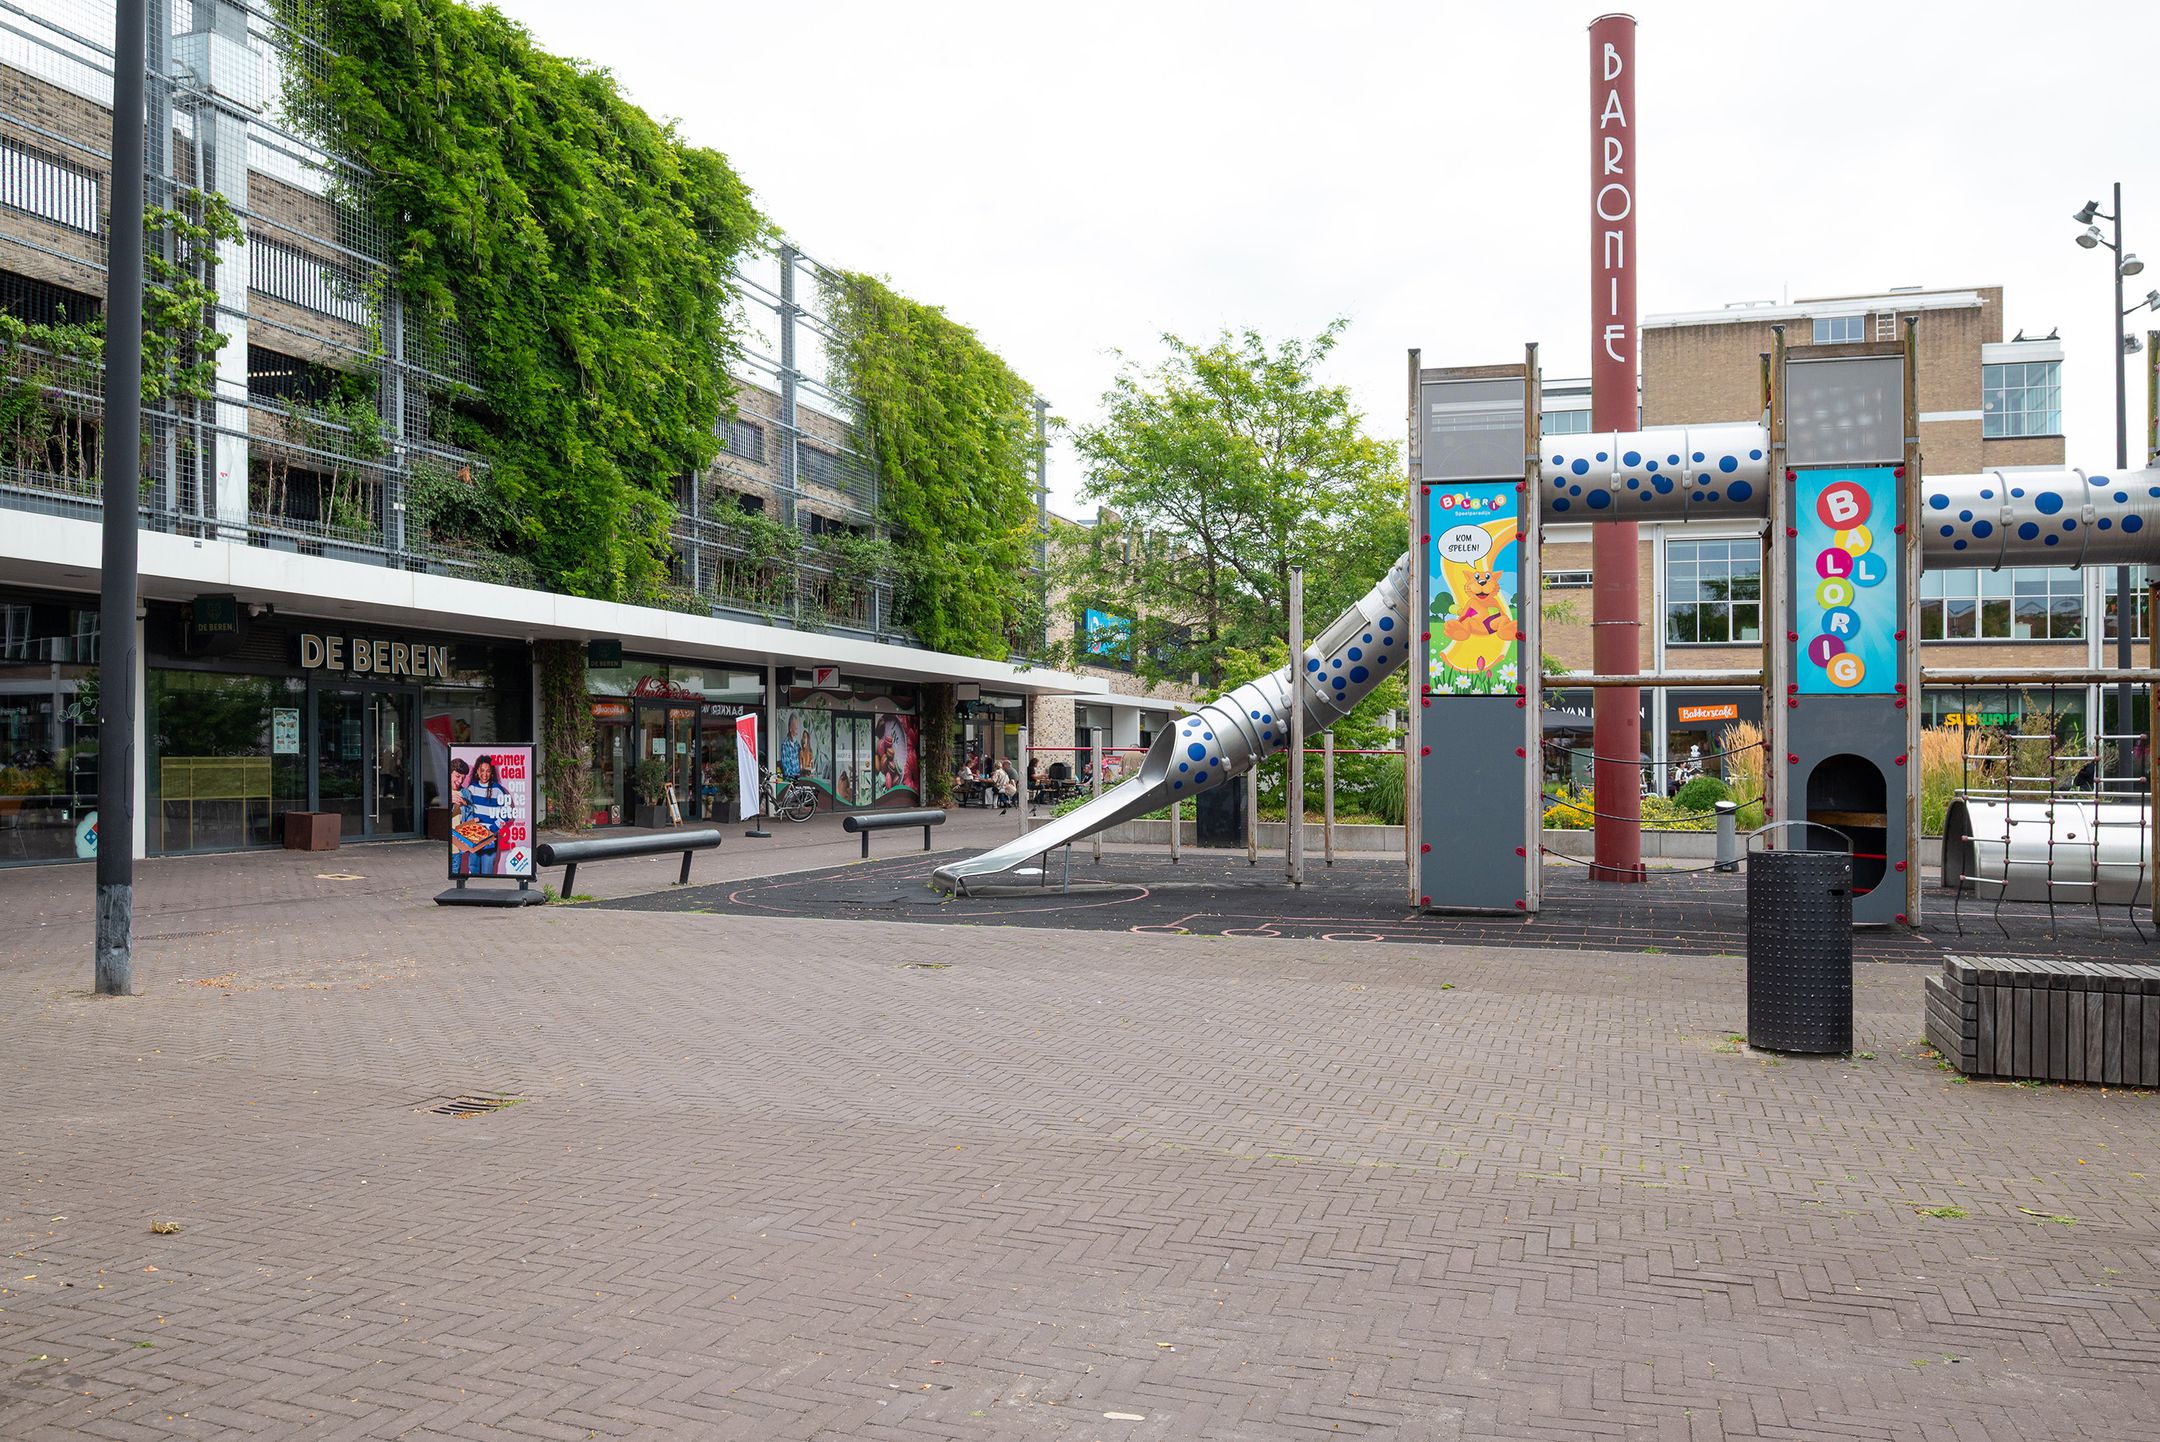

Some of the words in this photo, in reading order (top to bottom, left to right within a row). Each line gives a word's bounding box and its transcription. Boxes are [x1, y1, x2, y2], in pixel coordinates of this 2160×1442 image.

[1597, 42, 1631, 363] BARONIE
[1442, 491, 1504, 509] BALLORIG
[1456, 534, 1472, 542] KOM
[1448, 544, 1480, 552] SPELEN!
[1823, 489, 1876, 681] BALLORIG
[198, 623, 208, 632] DE
[208, 623, 233, 632] BEREN
[301, 633, 345, 671] DE
[352, 638, 449, 678] BEREN
[490, 754, 526, 766] zomer
[501, 766, 526, 779] deal
[509, 781, 526, 792] om
[496, 793, 512, 807] op
[513, 794, 526, 806] te
[489, 806, 526, 819] vreten
